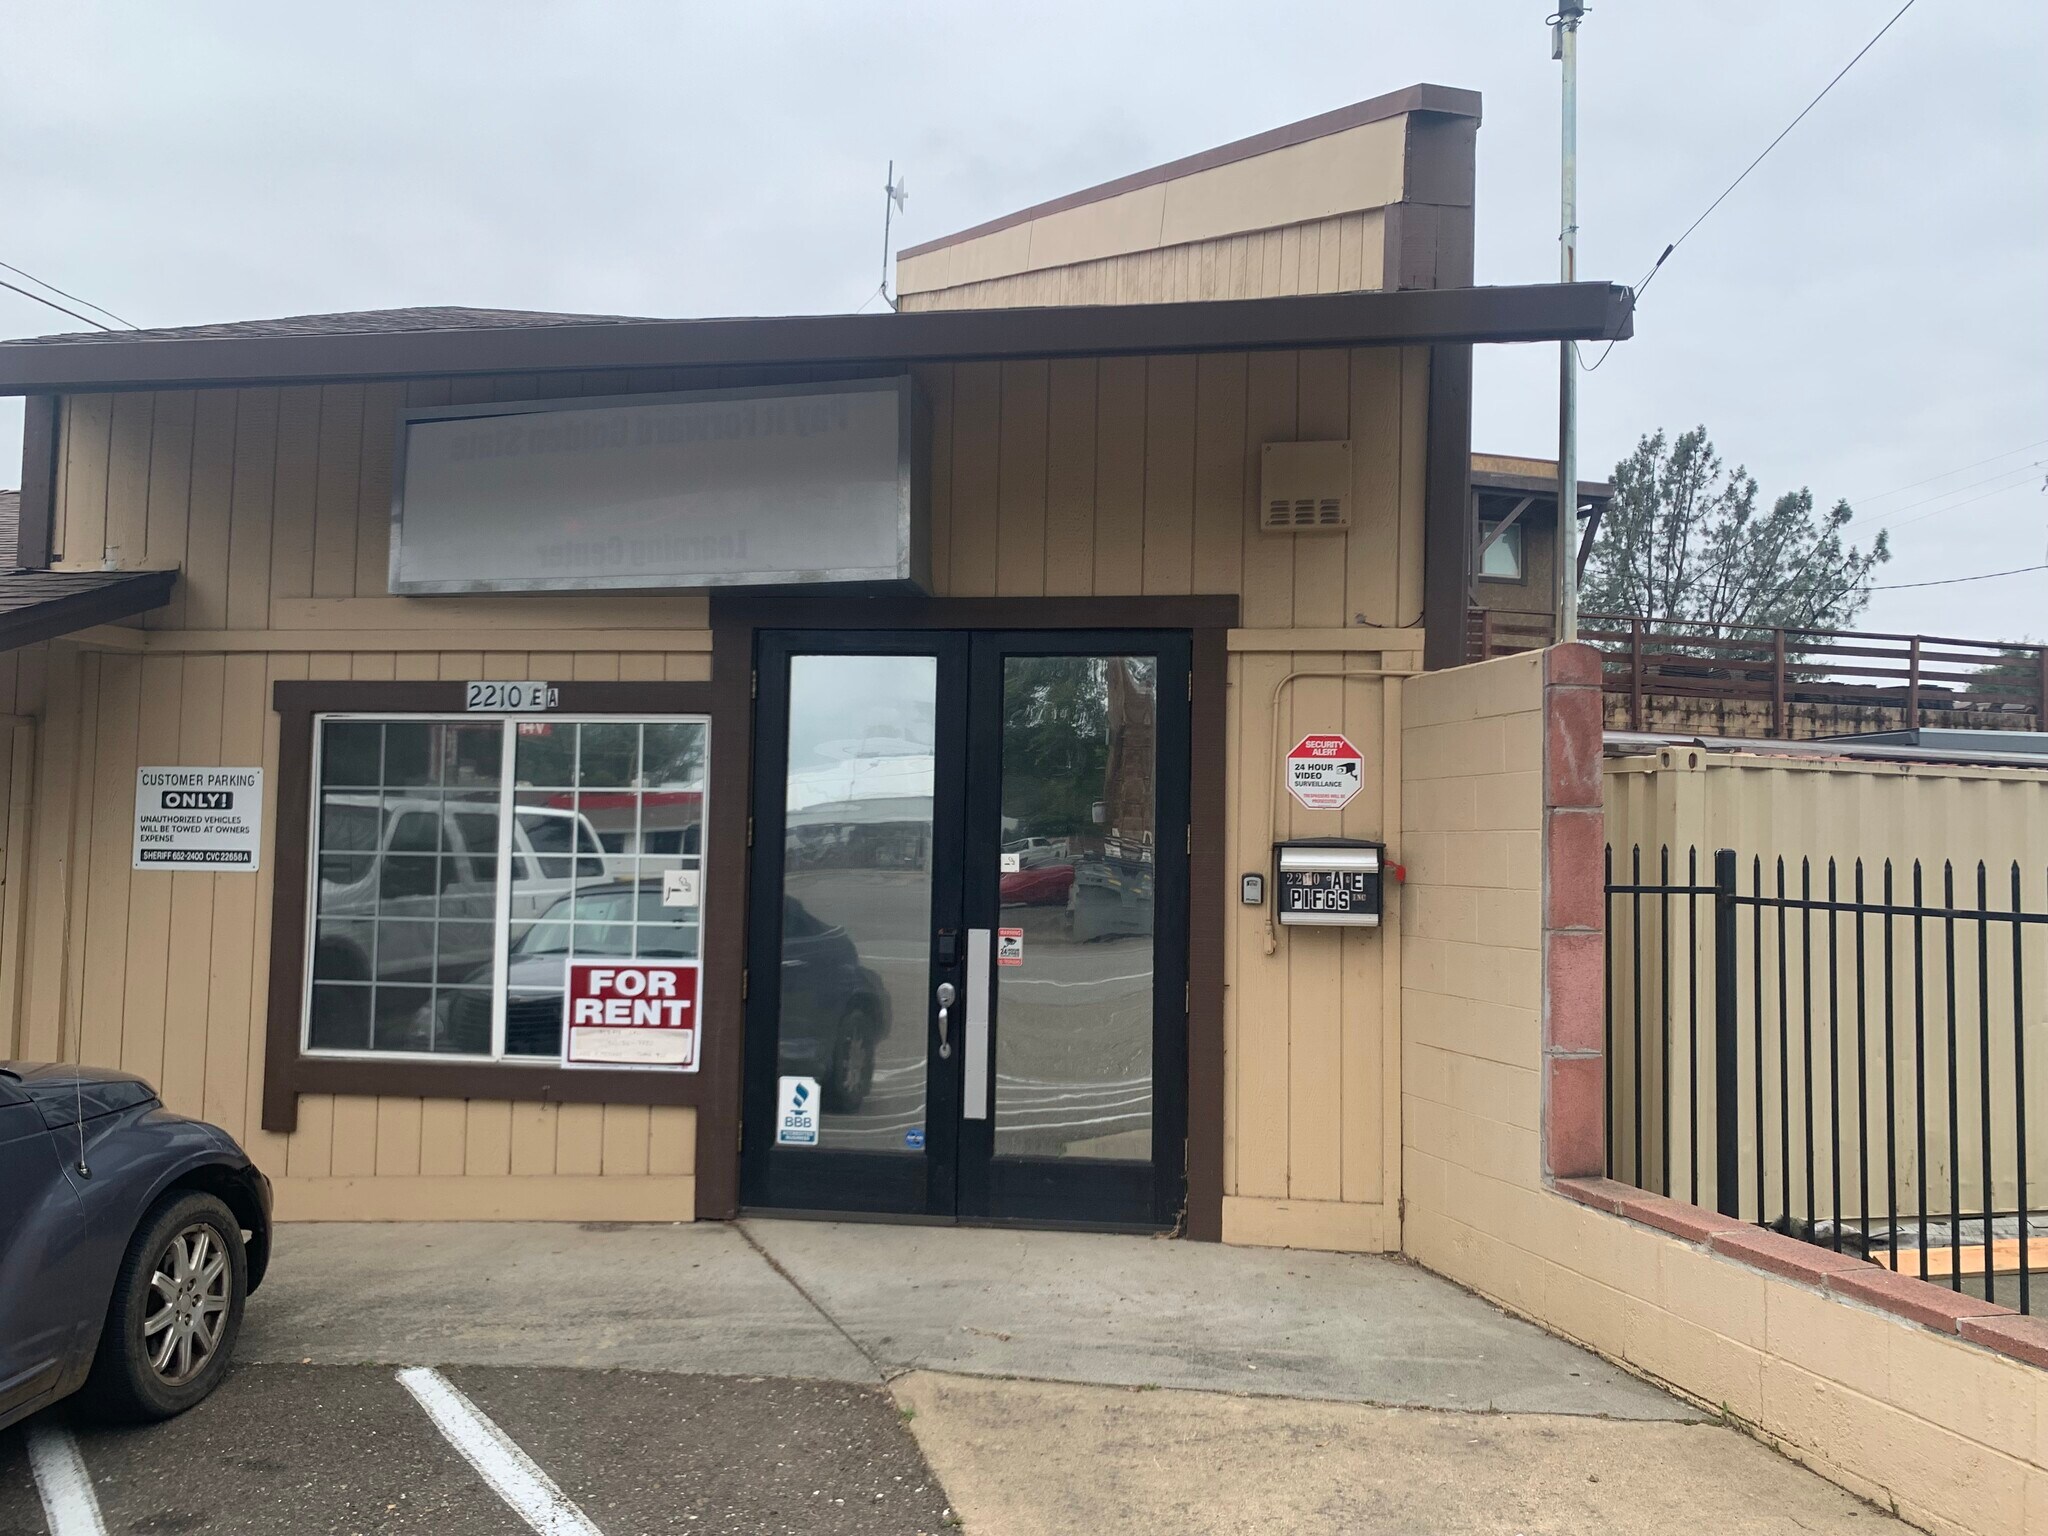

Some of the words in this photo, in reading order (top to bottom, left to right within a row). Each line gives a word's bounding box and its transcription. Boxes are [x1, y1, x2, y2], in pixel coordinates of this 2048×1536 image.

[469, 684, 522, 708] 2210
[548, 689, 557, 706] A
[1305, 740, 1345, 749] SECURITY
[1312, 748, 1338, 756] ALERT
[1294, 763, 1305, 771] 24
[1308, 763, 1334, 771] HOUR
[142, 773, 204, 786] CUSTOMER
[208, 774, 255, 787] PARKING
[1294, 772, 1322, 780] VIDEO
[165, 792, 227, 808] ONLY!
[140, 815, 202, 824] UNAUTHORIZED
[204, 816, 242, 825] VEHICLES
[140, 825, 158, 833] WILL
[160, 825, 170, 833] BE
[172, 825, 201, 833] TOWED
[215, 826, 250, 834] OWNERS
[140, 834, 174, 842] EXPENSE
[143, 850, 171, 860] SHERIFF
[205, 851, 220, 861] CVC
[1352, 872, 1363, 891] E
[1291, 889, 1349, 909] PIFGS
[1352, 893, 1367, 901] INC
[590, 969, 677, 997] FOR
[575, 998, 691, 1026] RENT
[784, 1116, 812, 1128] BBB
